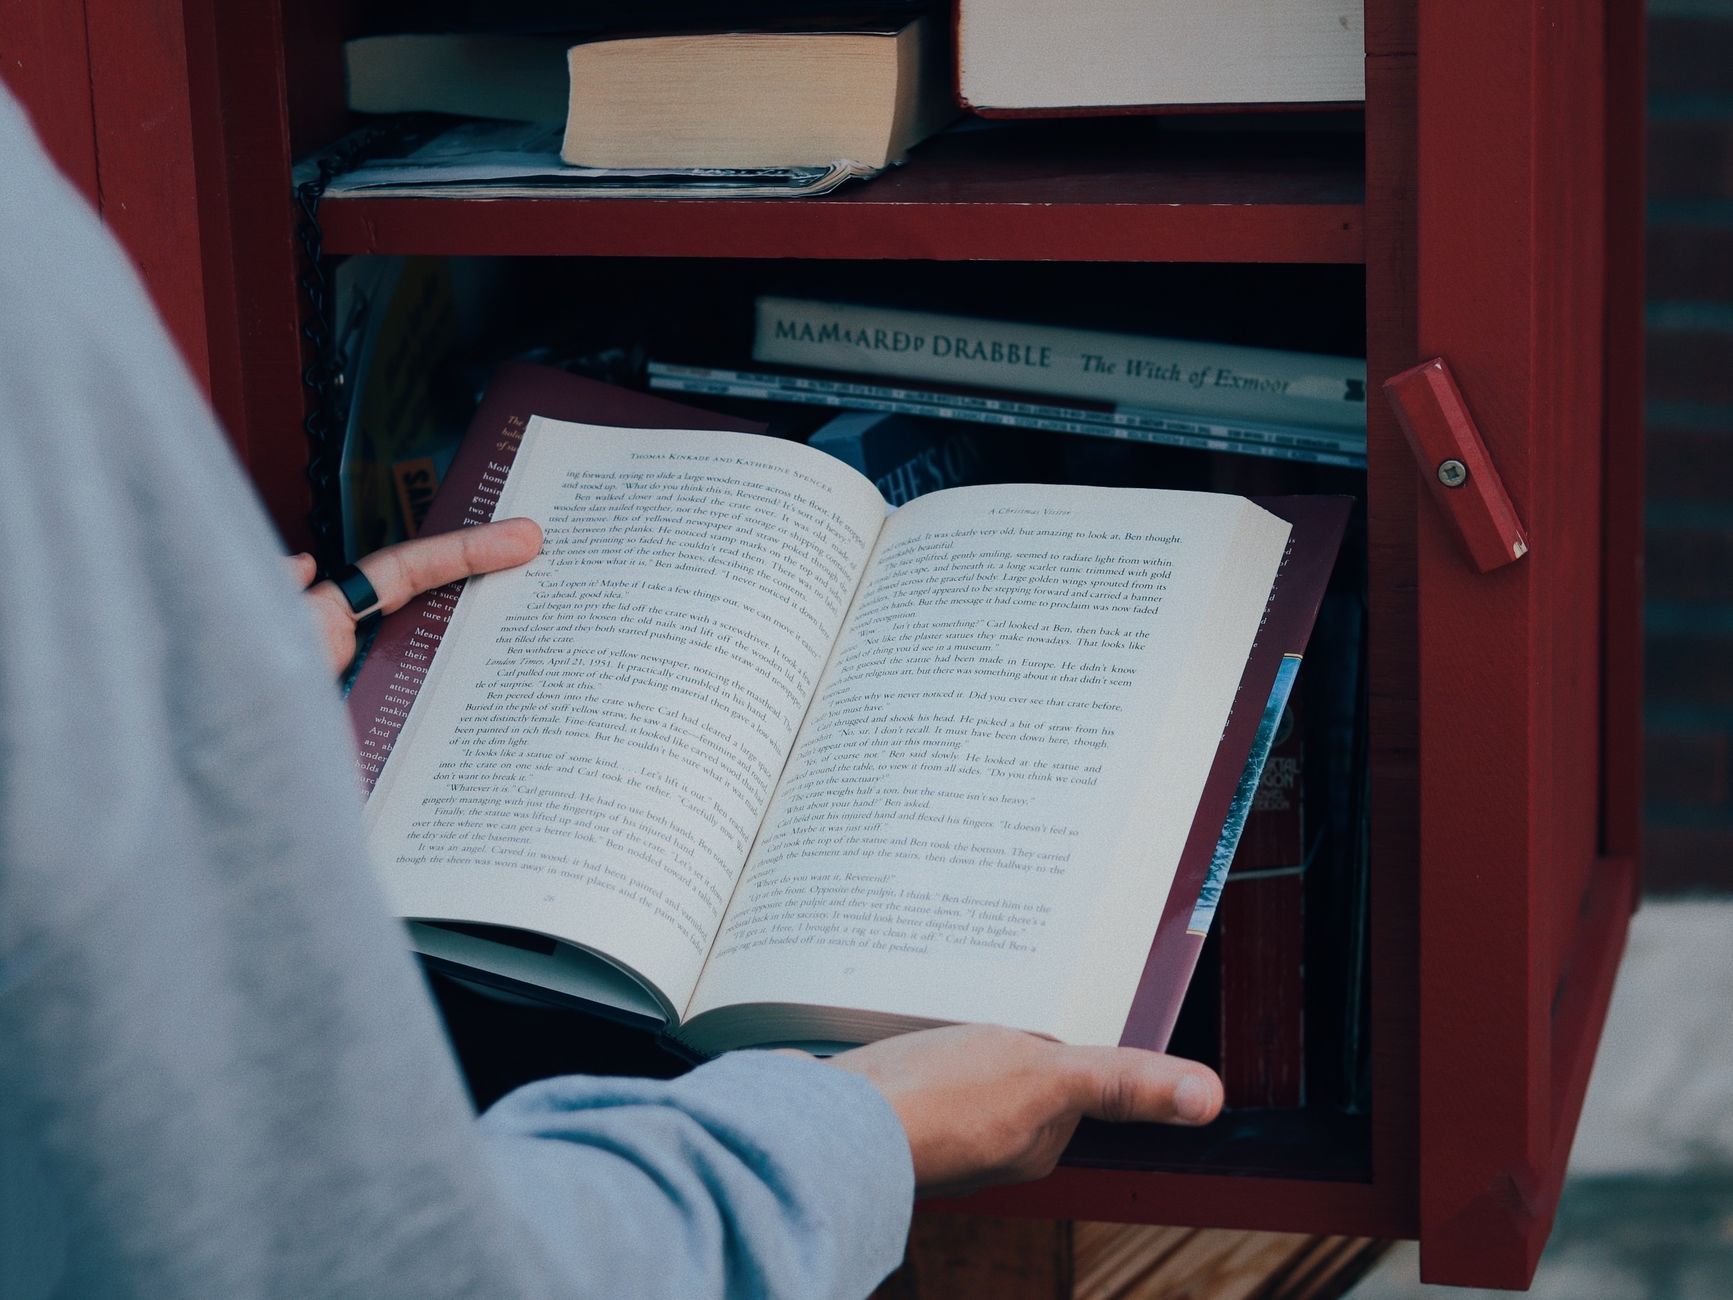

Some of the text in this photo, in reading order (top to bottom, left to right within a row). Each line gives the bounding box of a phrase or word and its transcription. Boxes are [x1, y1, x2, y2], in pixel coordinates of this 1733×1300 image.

[932, 334, 1052, 368] DRABBLE
[1080, 354, 1116, 375] The
[1124, 360, 1181, 382] Witch
[1188, 365, 1214, 389] of
[1214, 369, 1290, 394] Exmoor
[668, 453, 710, 461] KINKADE
[488, 461, 510, 474] Moll
[472, 495, 496, 506] gotte
[579, 482, 603, 490] stood
[662, 484, 679, 496] you
[680, 483, 704, 492] think
[705, 485, 722, 494] this
[782, 500, 796, 512] It's
[797, 509, 813, 521] sort
[814, 518, 824, 527] of
[468, 505, 484, 516] two
[574, 492, 591, 501] Ben
[595, 493, 626, 501] walked
[628, 492, 652, 500] closer
[656, 493, 674, 501] and
[676, 494, 710, 504] looked
[710, 497, 726, 506] the
[728, 502, 751, 510] crate
[781, 513, 790, 523] It
[793, 520, 809, 532] was
[950, 551, 977, 562] gently
[1016, 551, 1049, 559] seemed
[1062, 553, 1093, 562] radiate
[1094, 554, 1116, 565] light
[1117, 555, 1140, 565] from
[951, 562, 984, 571] beneath
[1006, 561, 1026, 572] long
[1029, 563, 1057, 572] scarlet
[1085, 566, 1126, 576] trimmed
[1127, 568, 1148, 577] with
[1149, 570, 1172, 580] gold
[578, 590, 603, 600] good
[426, 598, 442, 609] she
[422, 610, 440, 622] ture
[986, 620, 1007, 628] Carl
[1008, 620, 1039, 631] looked
[1076, 625, 1097, 635] then
[1099, 626, 1120, 636] back
[1135, 629, 1150, 639] the
[410, 638, 430, 650] have
[495, 635, 512, 643] that
[514, 635, 536, 643] filled
[537, 634, 552, 643] the
[881, 634, 896, 643] like
[914, 632, 943, 642] plaster
[976, 630, 996, 641] they
[999, 632, 1024, 642] make
[1077, 637, 1098, 647] That
[1101, 639, 1125, 649] looks
[1128, 641, 1146, 651] like
[404, 650, 428, 661] their
[400, 662, 428, 674] uncon
[394, 670, 410, 681] she
[485, 657, 516, 666] London
[617, 661, 625, 669] It
[626, 664, 674, 680] practically
[675, 674, 720, 693] crumbled
[721, 688, 730, 699] in
[732, 693, 744, 706] his
[487, 680, 499, 688] of
[384, 694, 410, 708] tainty
[380, 706, 408, 718] makin
[375, 716, 402, 728] whose
[369, 726, 390, 738] And
[364, 739, 376, 747] an
[888, 750, 906, 758] Ben
[909, 749, 928, 758] said
[965, 753, 981, 763] He
[984, 755, 1016, 766] looked
[1033, 759, 1048, 769] the
[1083, 765, 1102, 773] and
[432, 772, 456, 780] don't
[492, 772, 516, 781] break
[406, 830, 421, 839] the
[439, 830, 457, 840] side
[458, 831, 471, 840] of
[471, 832, 486, 840] the
